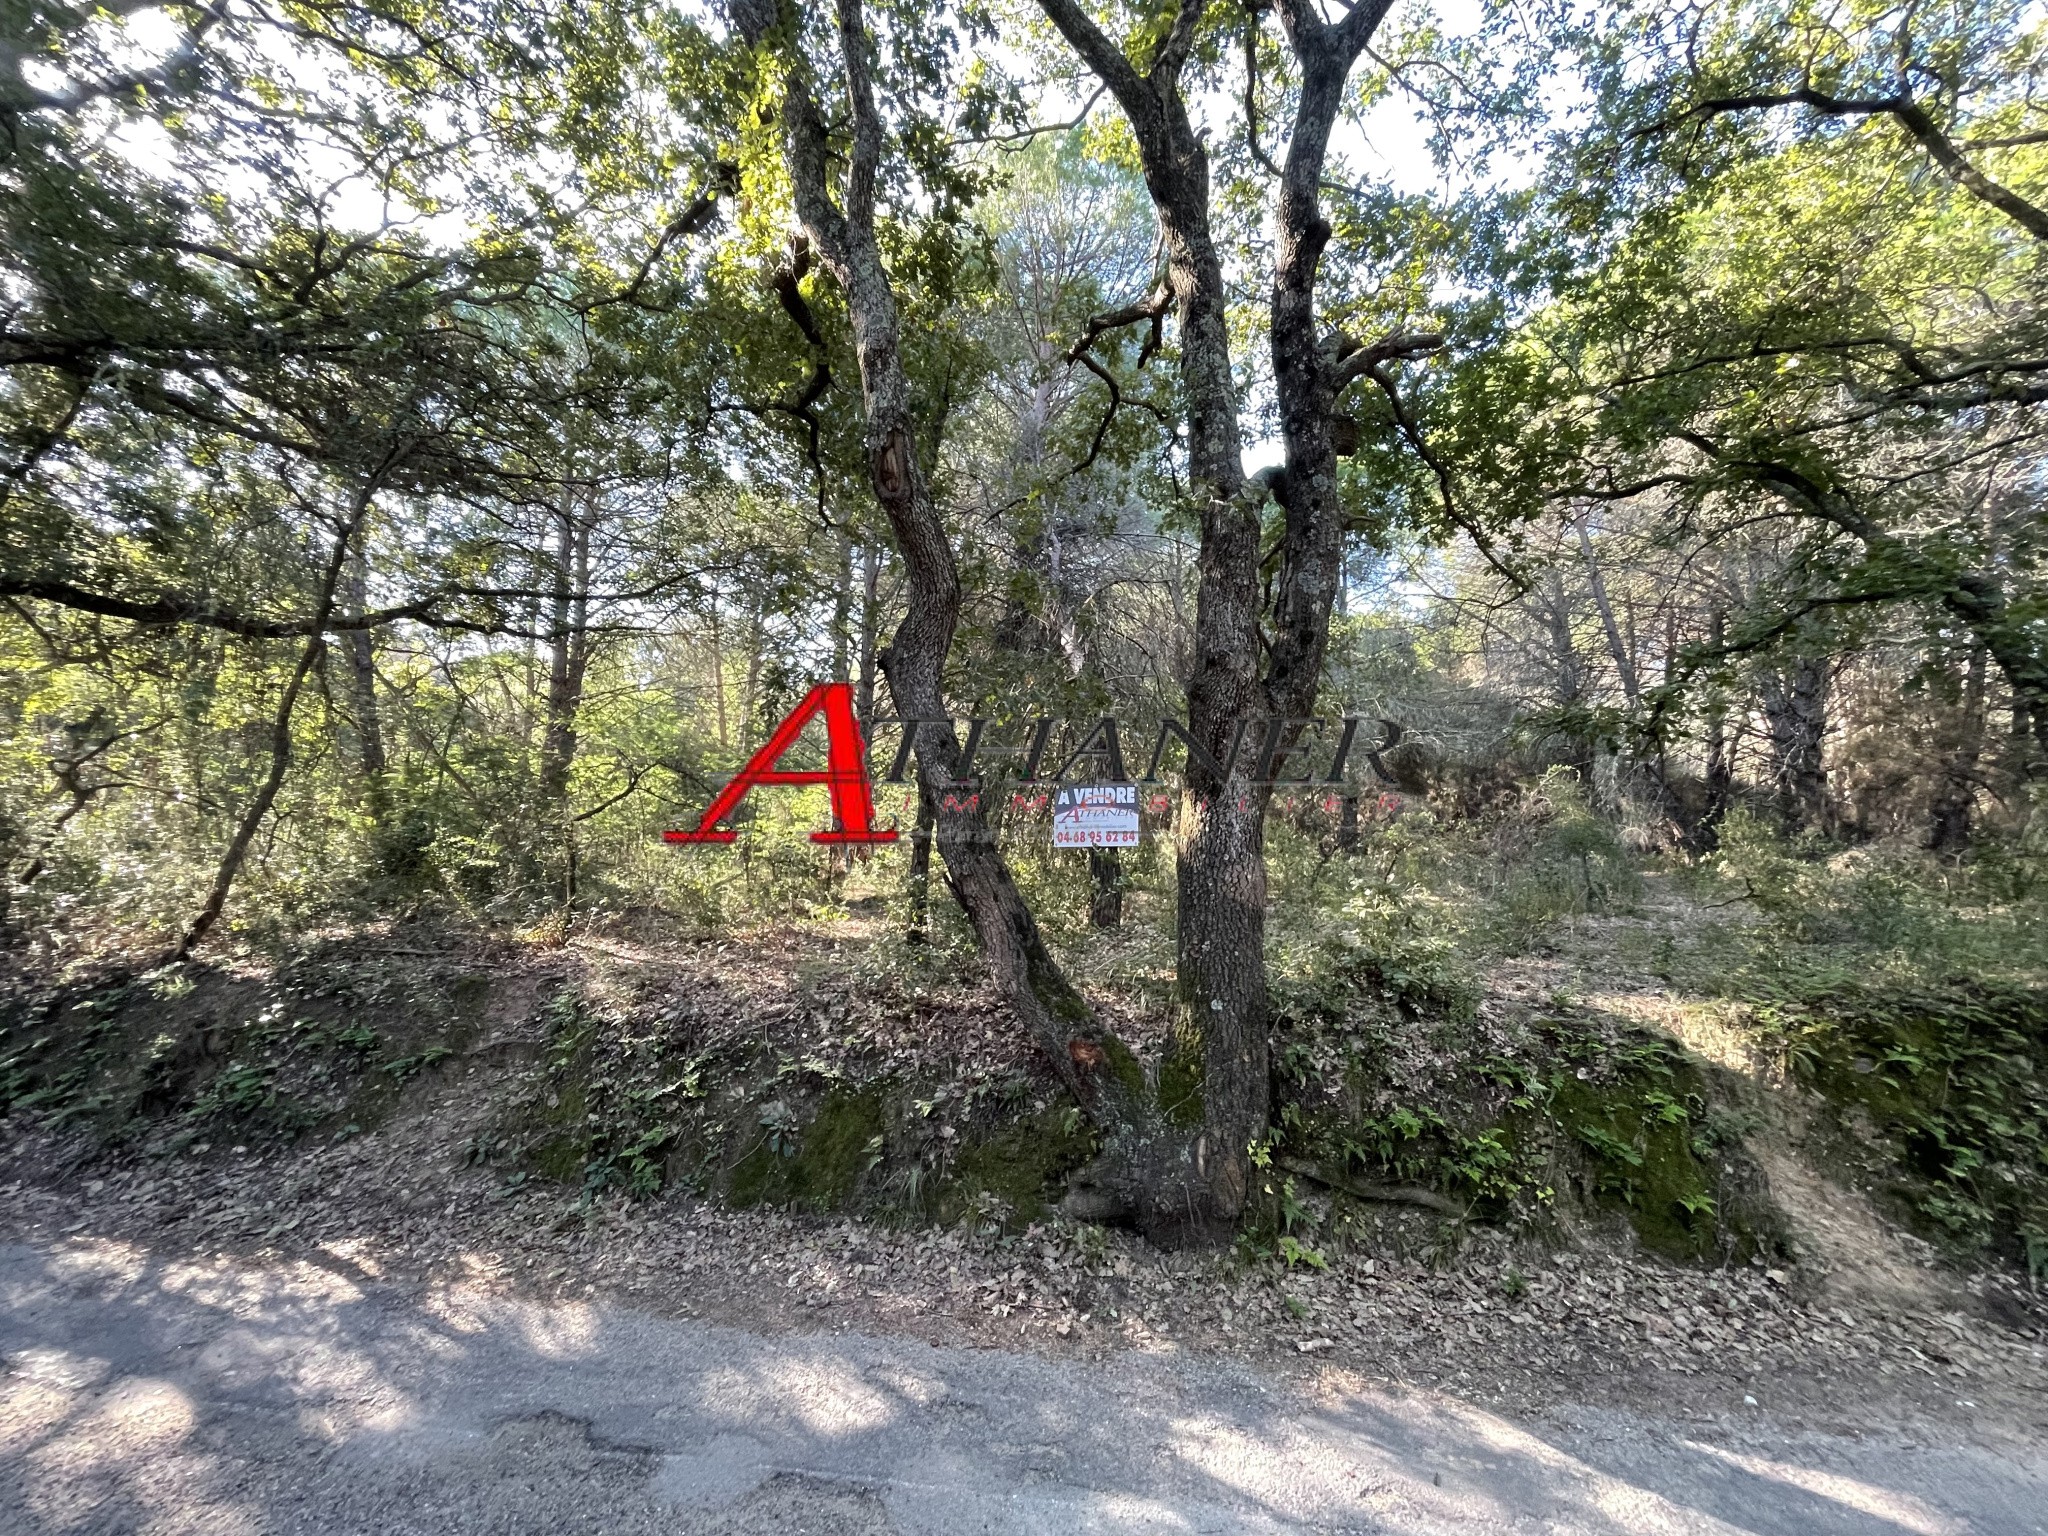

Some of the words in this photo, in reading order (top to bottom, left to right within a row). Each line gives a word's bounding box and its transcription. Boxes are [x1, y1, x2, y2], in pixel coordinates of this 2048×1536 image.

[1074, 787, 1135, 805] VENDRE
[1058, 805, 1134, 823] ATHANER
[1089, 831, 1102, 843] 95
[1105, 831, 1118, 842] 62
[1122, 831, 1135, 842] 84
